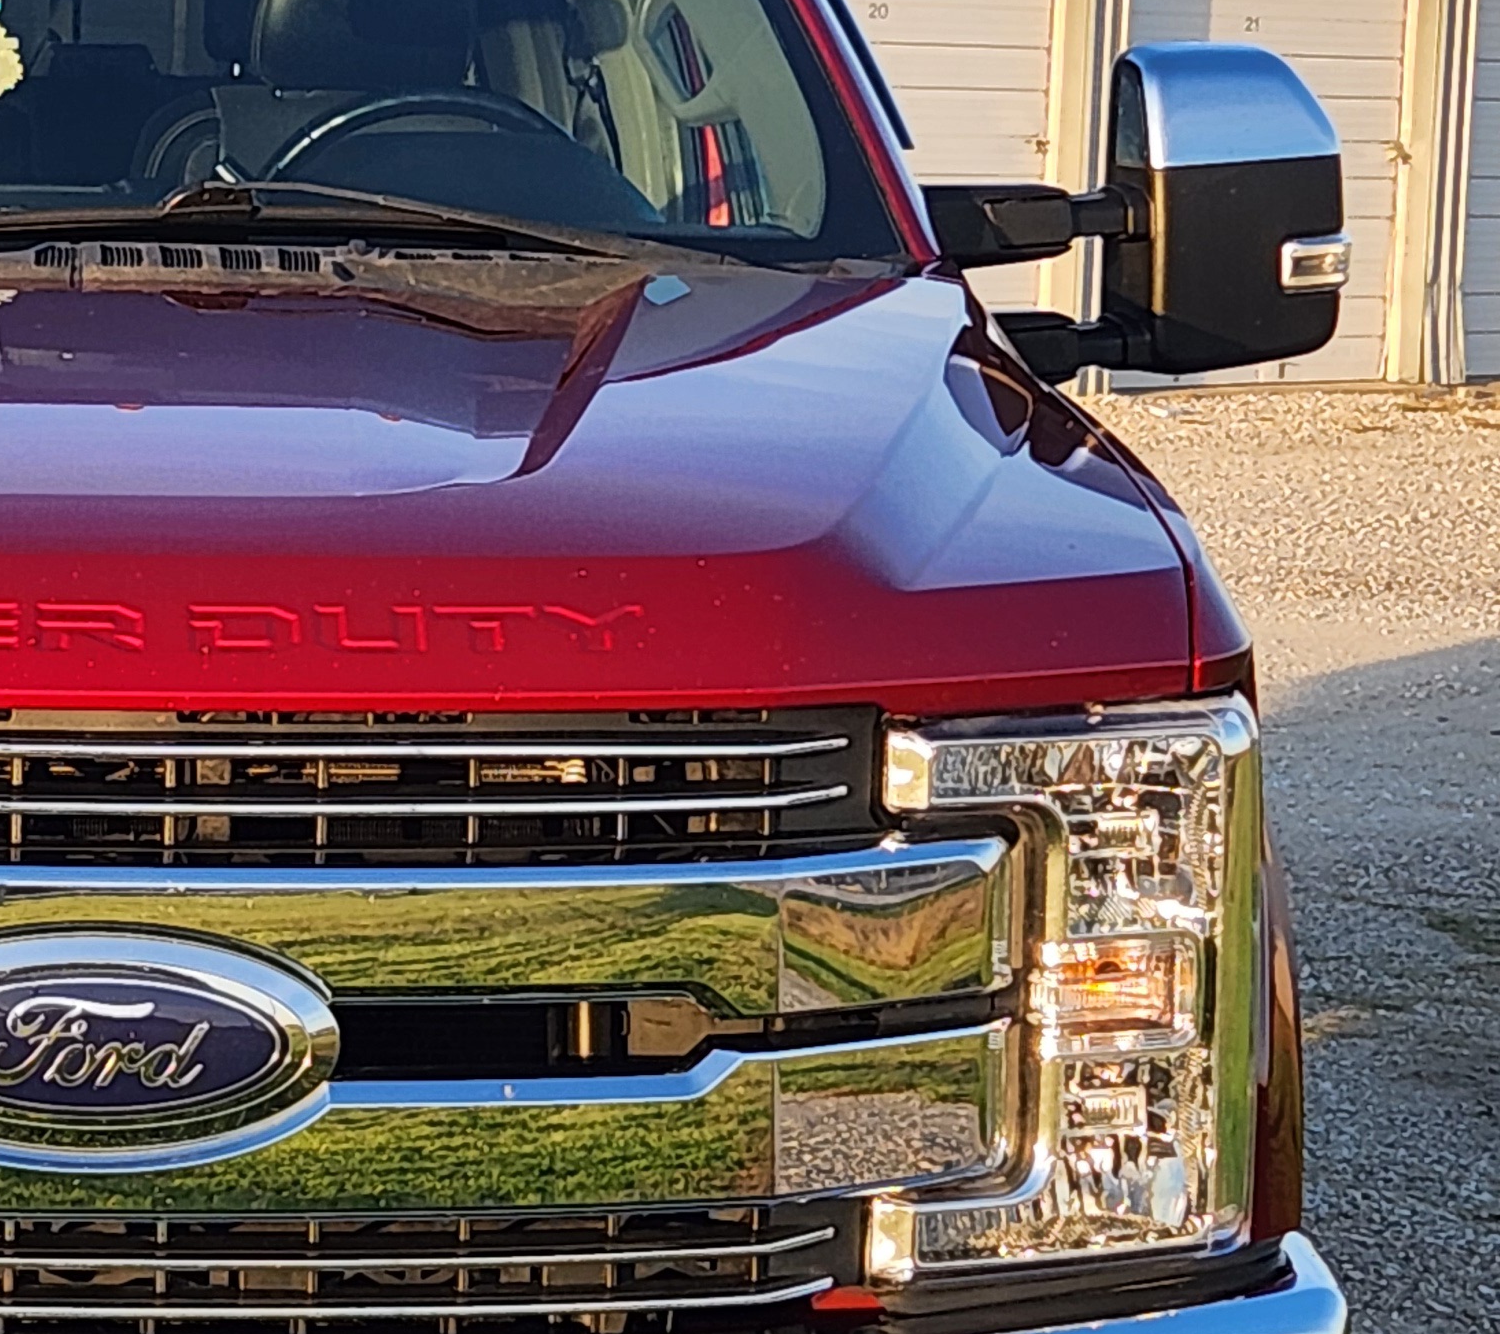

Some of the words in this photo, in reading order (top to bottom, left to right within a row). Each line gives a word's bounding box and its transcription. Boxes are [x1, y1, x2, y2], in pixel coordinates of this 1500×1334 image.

[868, 2, 889, 19] 20
[1244, 16, 1260, 33] 21
[187, 603, 644, 653] DUTY
